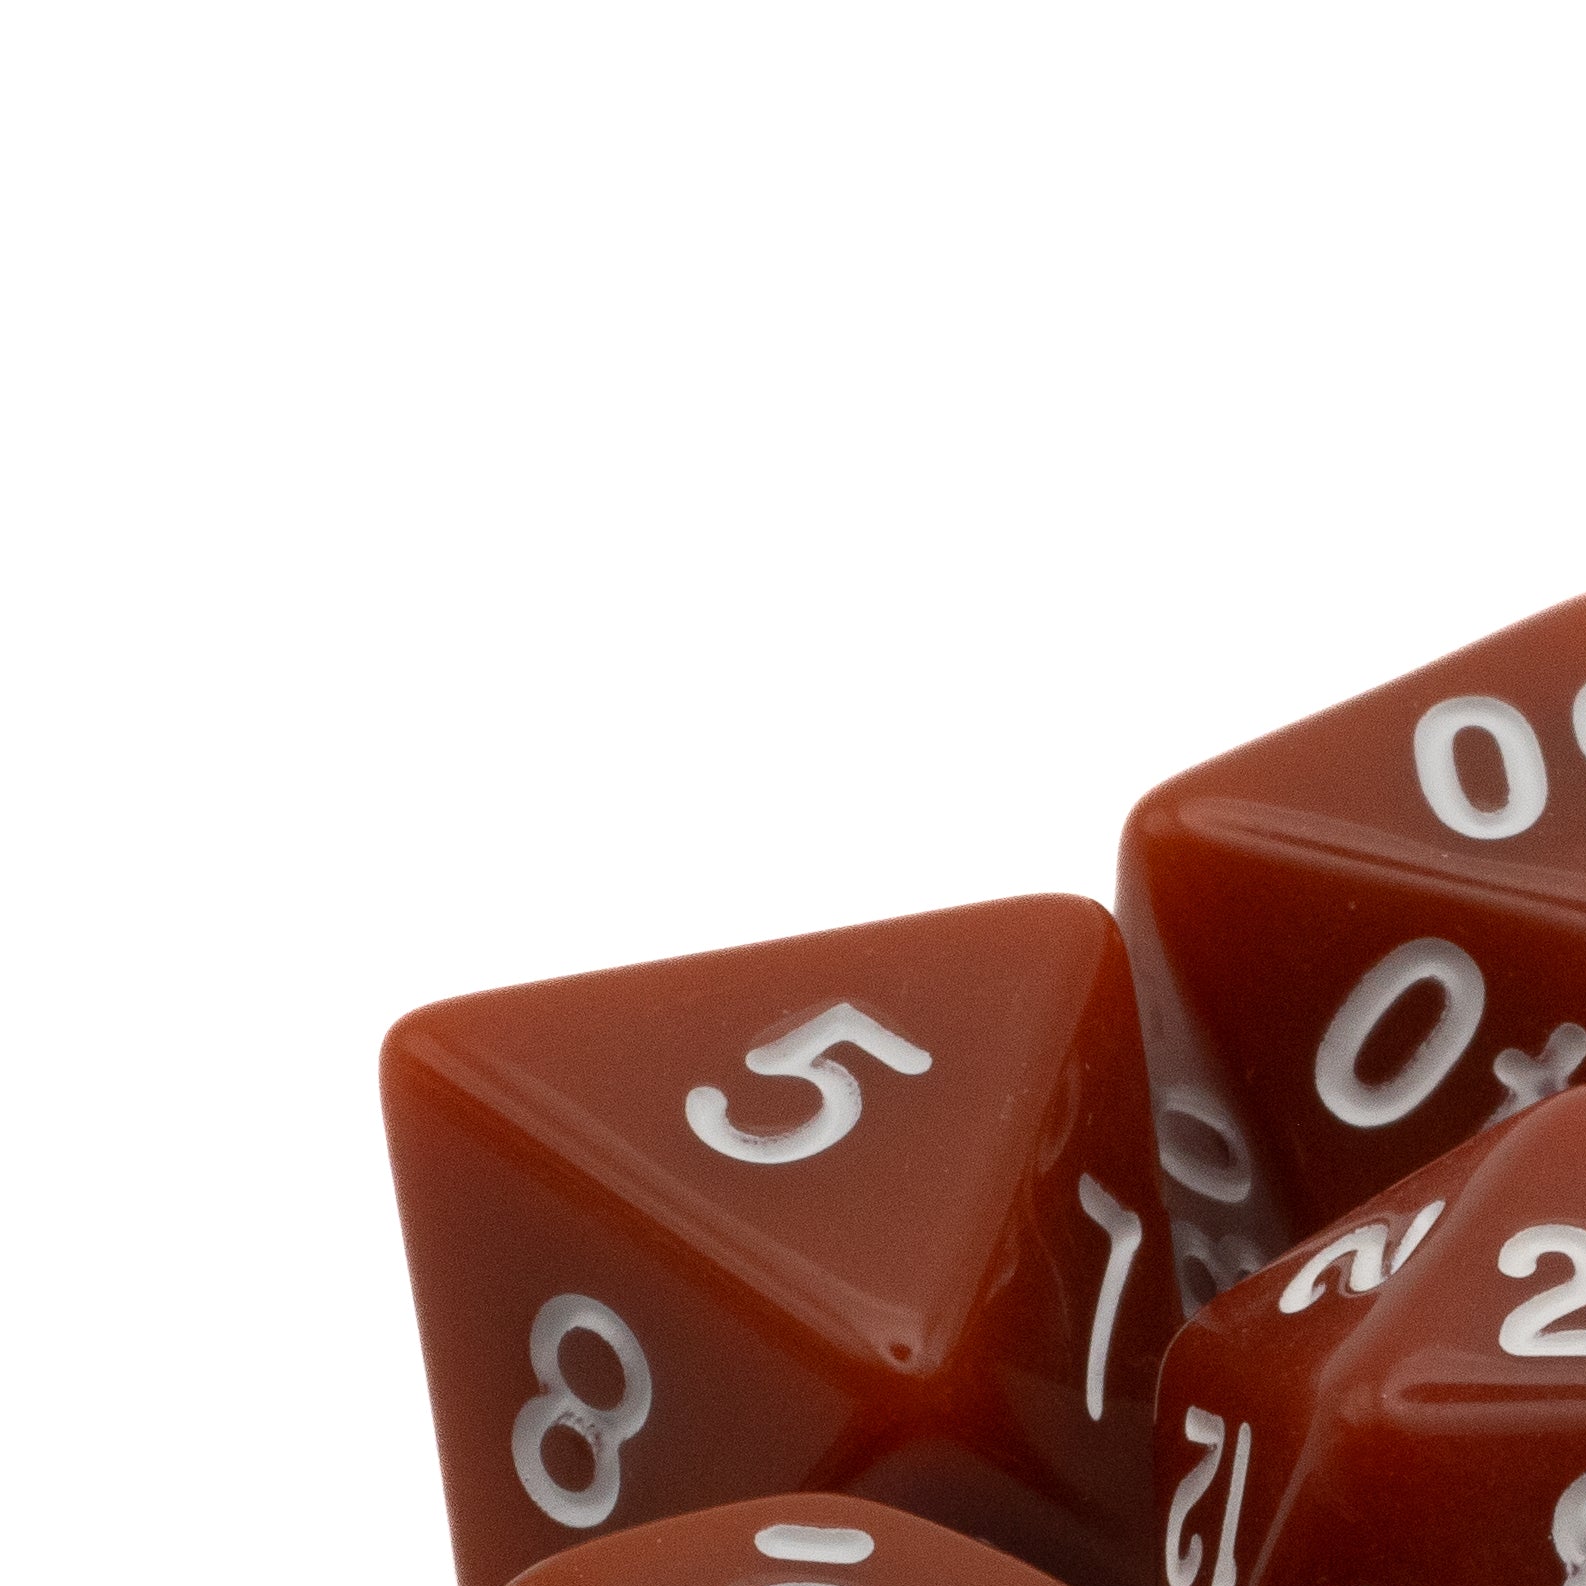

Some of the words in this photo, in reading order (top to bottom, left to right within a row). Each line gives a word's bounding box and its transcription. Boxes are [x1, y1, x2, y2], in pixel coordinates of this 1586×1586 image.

[685, 1002, 932, 1164] 5
[1278, 1199, 1446, 1315] 2
[511, 1293, 653, 1529] 8
